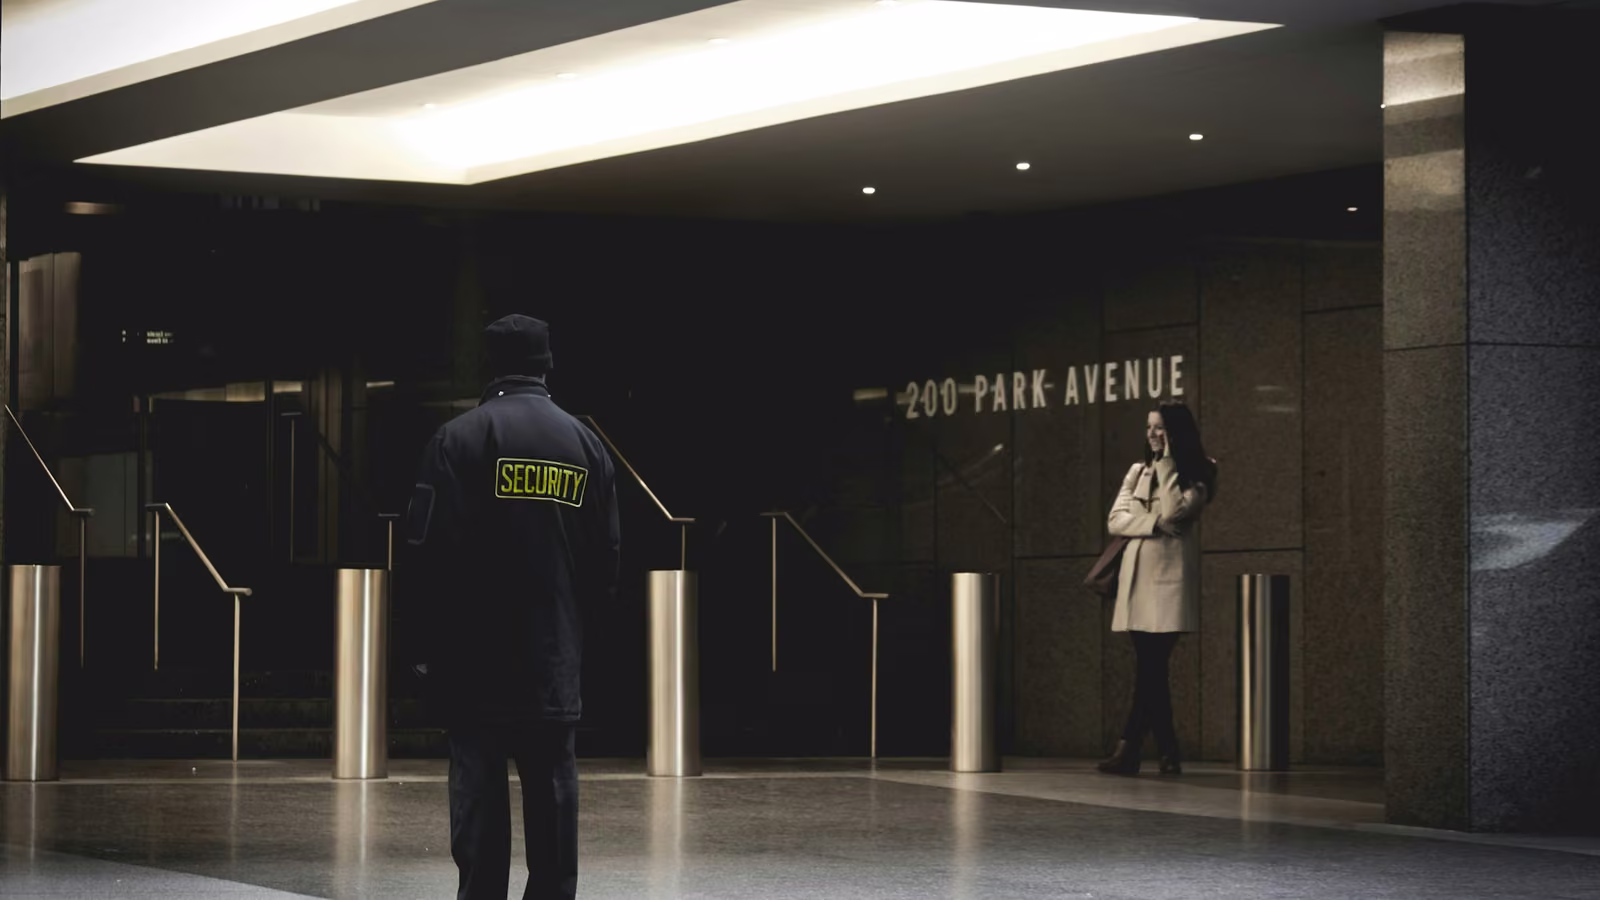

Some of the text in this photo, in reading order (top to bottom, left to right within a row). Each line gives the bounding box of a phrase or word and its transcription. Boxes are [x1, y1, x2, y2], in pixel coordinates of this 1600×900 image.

[905, 355, 1185, 419] 200 PARK AVENUE
[500, 464, 584, 501] SECURITY
